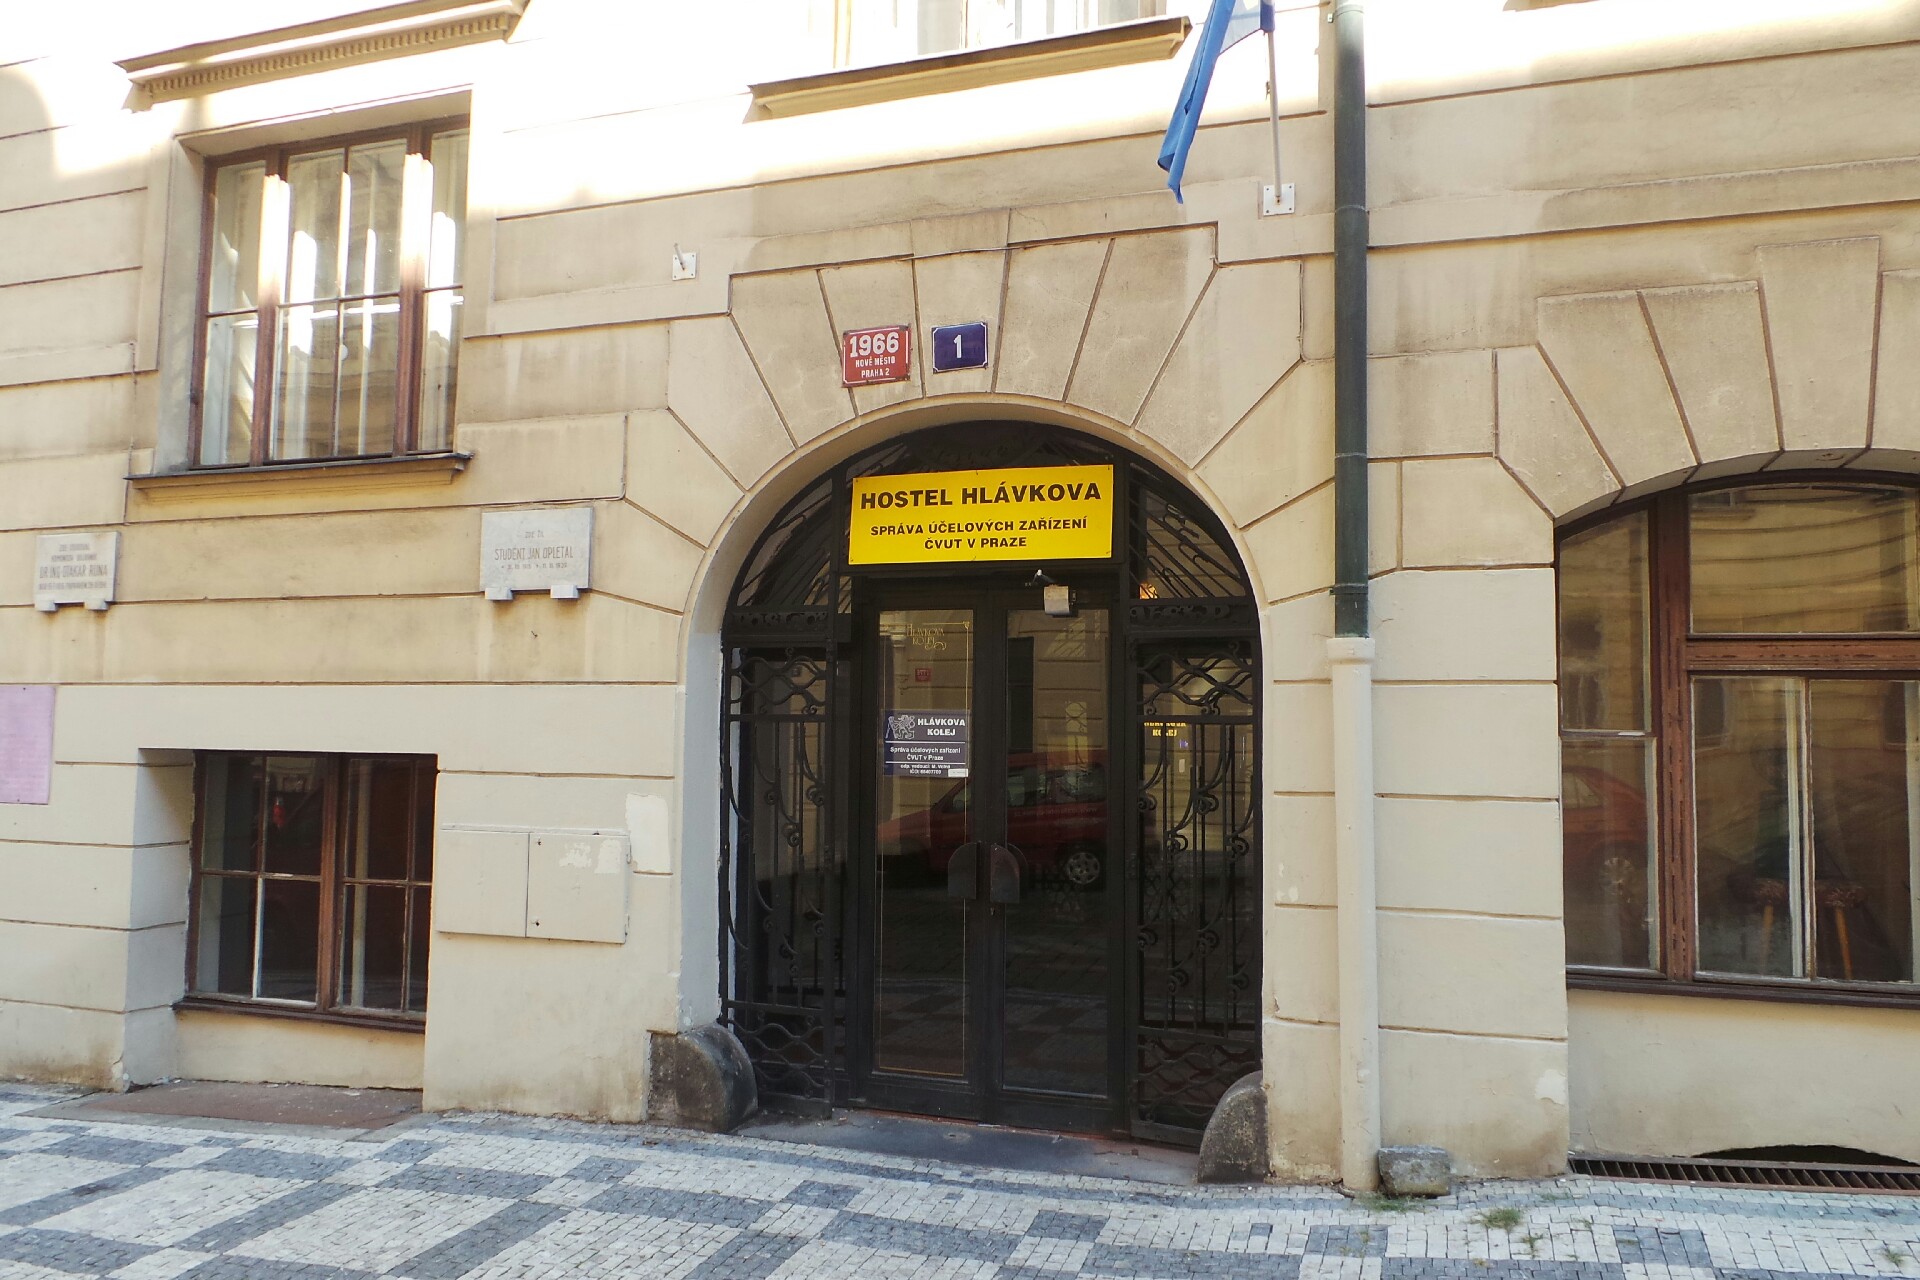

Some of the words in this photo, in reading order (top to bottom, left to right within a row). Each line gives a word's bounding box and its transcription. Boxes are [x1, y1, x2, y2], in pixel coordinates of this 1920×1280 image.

[850, 332, 899, 358] 1966
[953, 334, 962, 358] 1
[855, 356, 873, 368] NOVÉ
[874, 355, 896, 366] MĚSTO
[861, 369, 884, 378] PRAHA
[884, 367, 890, 376] 2
[860, 489, 953, 510] HOSTEL
[961, 481, 1102, 505] HLÁVKOVA
[870, 521, 924, 536] SPRÁVA
[928, 519, 1014, 534] ÚČELOVÝCH
[1018, 516, 1088, 531] ZAŘÍZENÍ
[924, 537, 963, 550] ČVUT
[967, 539, 976, 549] V
[980, 537, 1027, 548] PRAZE
[494, 548, 526, 560] STUDENT
[528, 548, 540, 560] JAN
[542, 546, 574, 559] OPLETAL
[917, 717, 966, 727] HLÁVKOVA
[927, 728, 956, 736] KOLEJ
[890, 746, 910, 754] Správa
